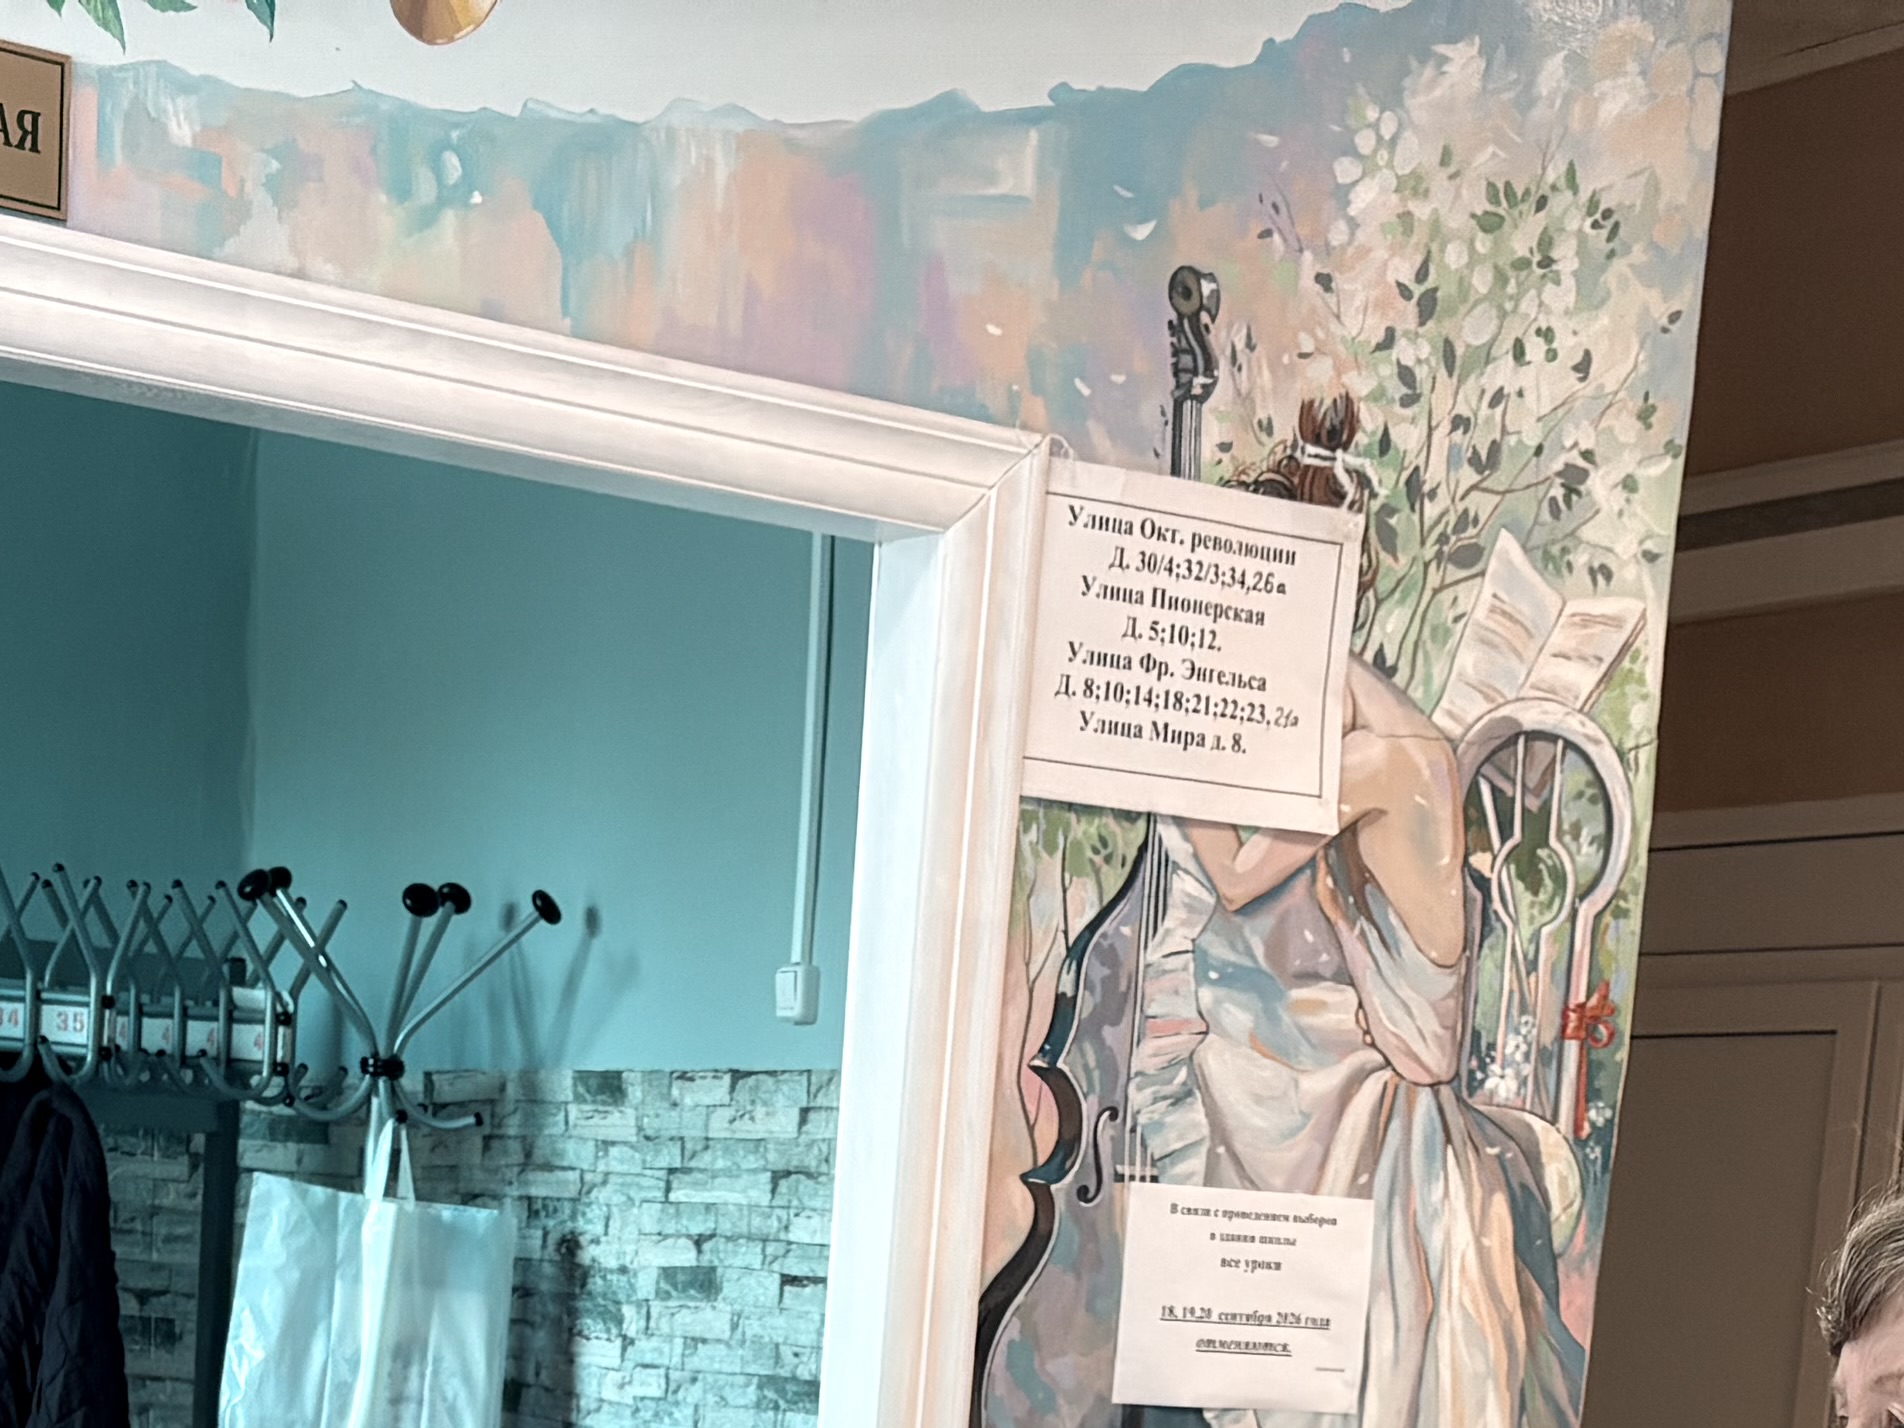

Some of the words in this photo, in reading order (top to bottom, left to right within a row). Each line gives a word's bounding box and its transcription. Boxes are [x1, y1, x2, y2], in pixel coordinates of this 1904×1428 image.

[1067, 504, 1134, 536] Улица
[1140, 517, 1185, 546] Окт.
[1191, 531, 1297, 566] революции
[1108, 545, 1130, 570] Д.
[1081, 574, 1144, 605] Улица
[1151, 586, 1266, 627] Пионерская
[1121, 616, 1143, 640] Д.
[1148, 620, 1222, 652] 5;10;12.
[1054, 673, 1077, 698] Д.
[1067, 640, 1133, 671] Улица
[1139, 652, 1175, 682] Фр.
[1181, 659, 1267, 692] Энгельса
[1080, 710, 1143, 740] Улица
[1150, 721, 1206, 752] Мира
[1210, 735, 1227, 752] д.
[1231, 732, 1247, 754] 8.
[56, 1010, 84, 1034] 35
